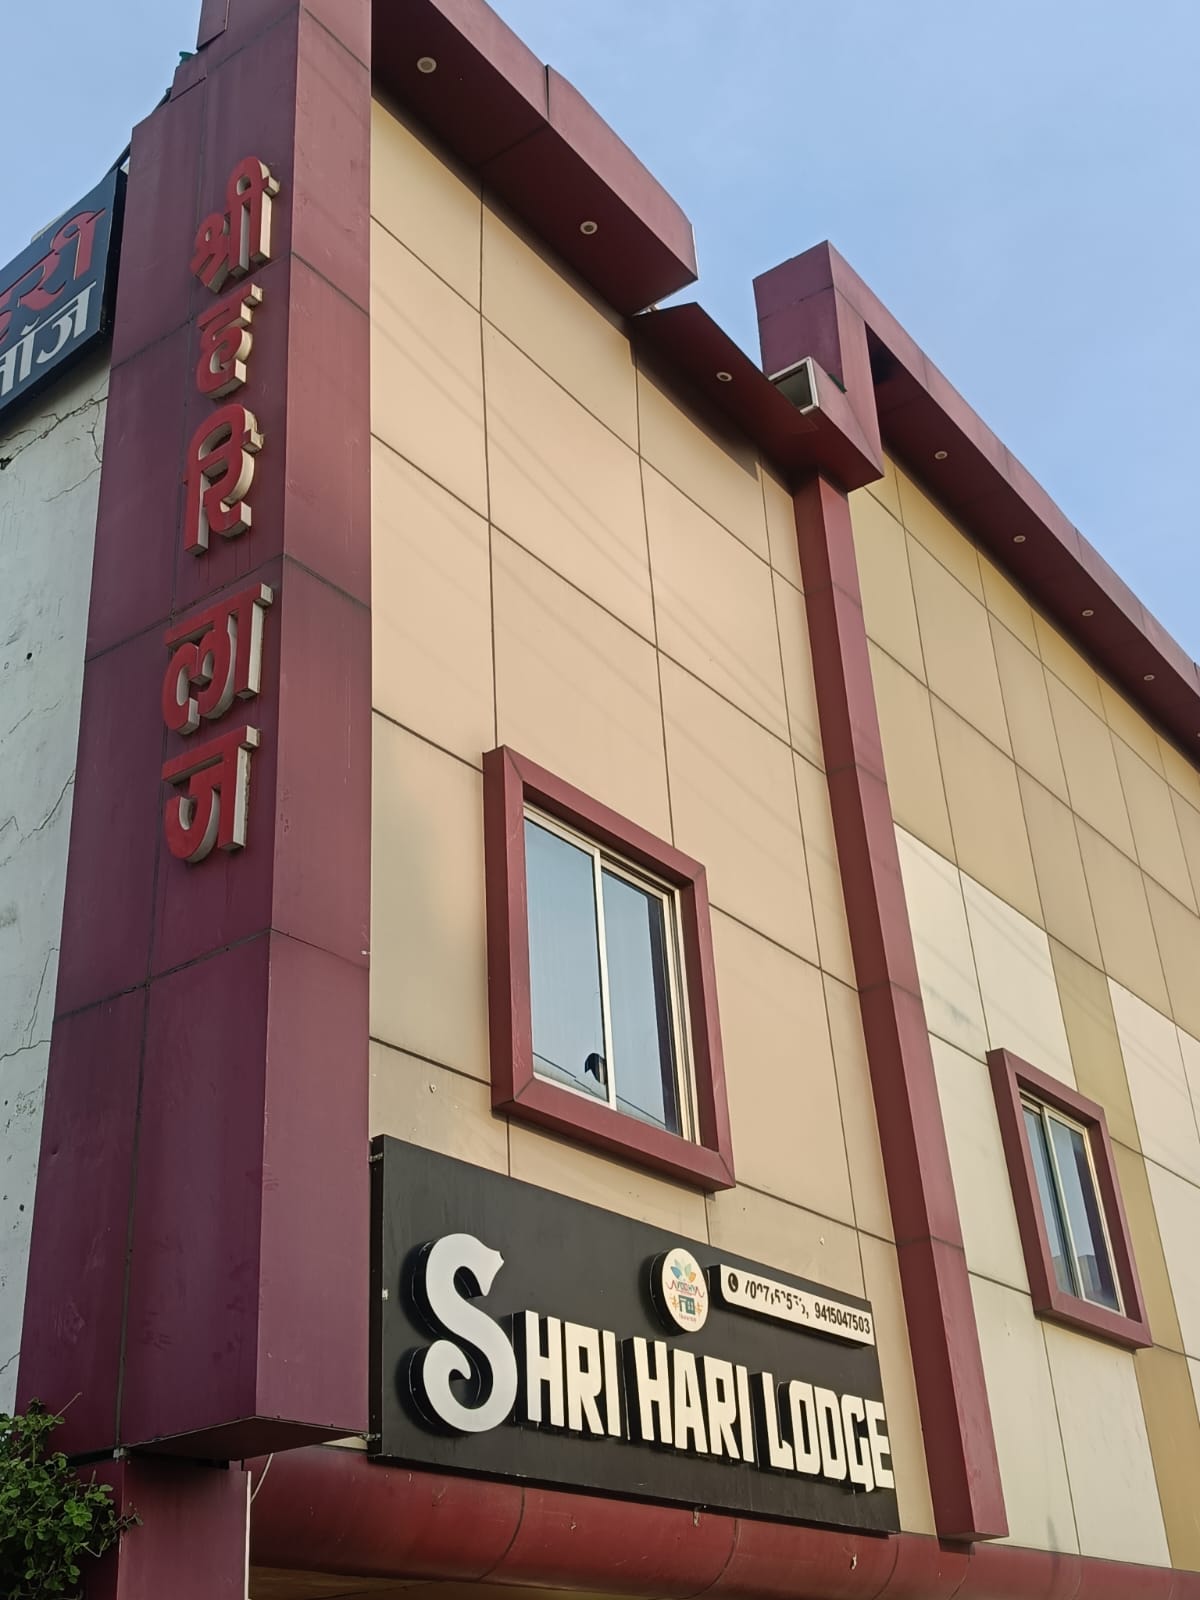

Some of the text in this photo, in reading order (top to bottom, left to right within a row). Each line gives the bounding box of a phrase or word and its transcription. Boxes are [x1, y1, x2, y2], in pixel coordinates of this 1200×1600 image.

[422, 1232, 895, 1492] SHRI HARI LODGE
[814, 1302, 871, 1334] 9415047503
